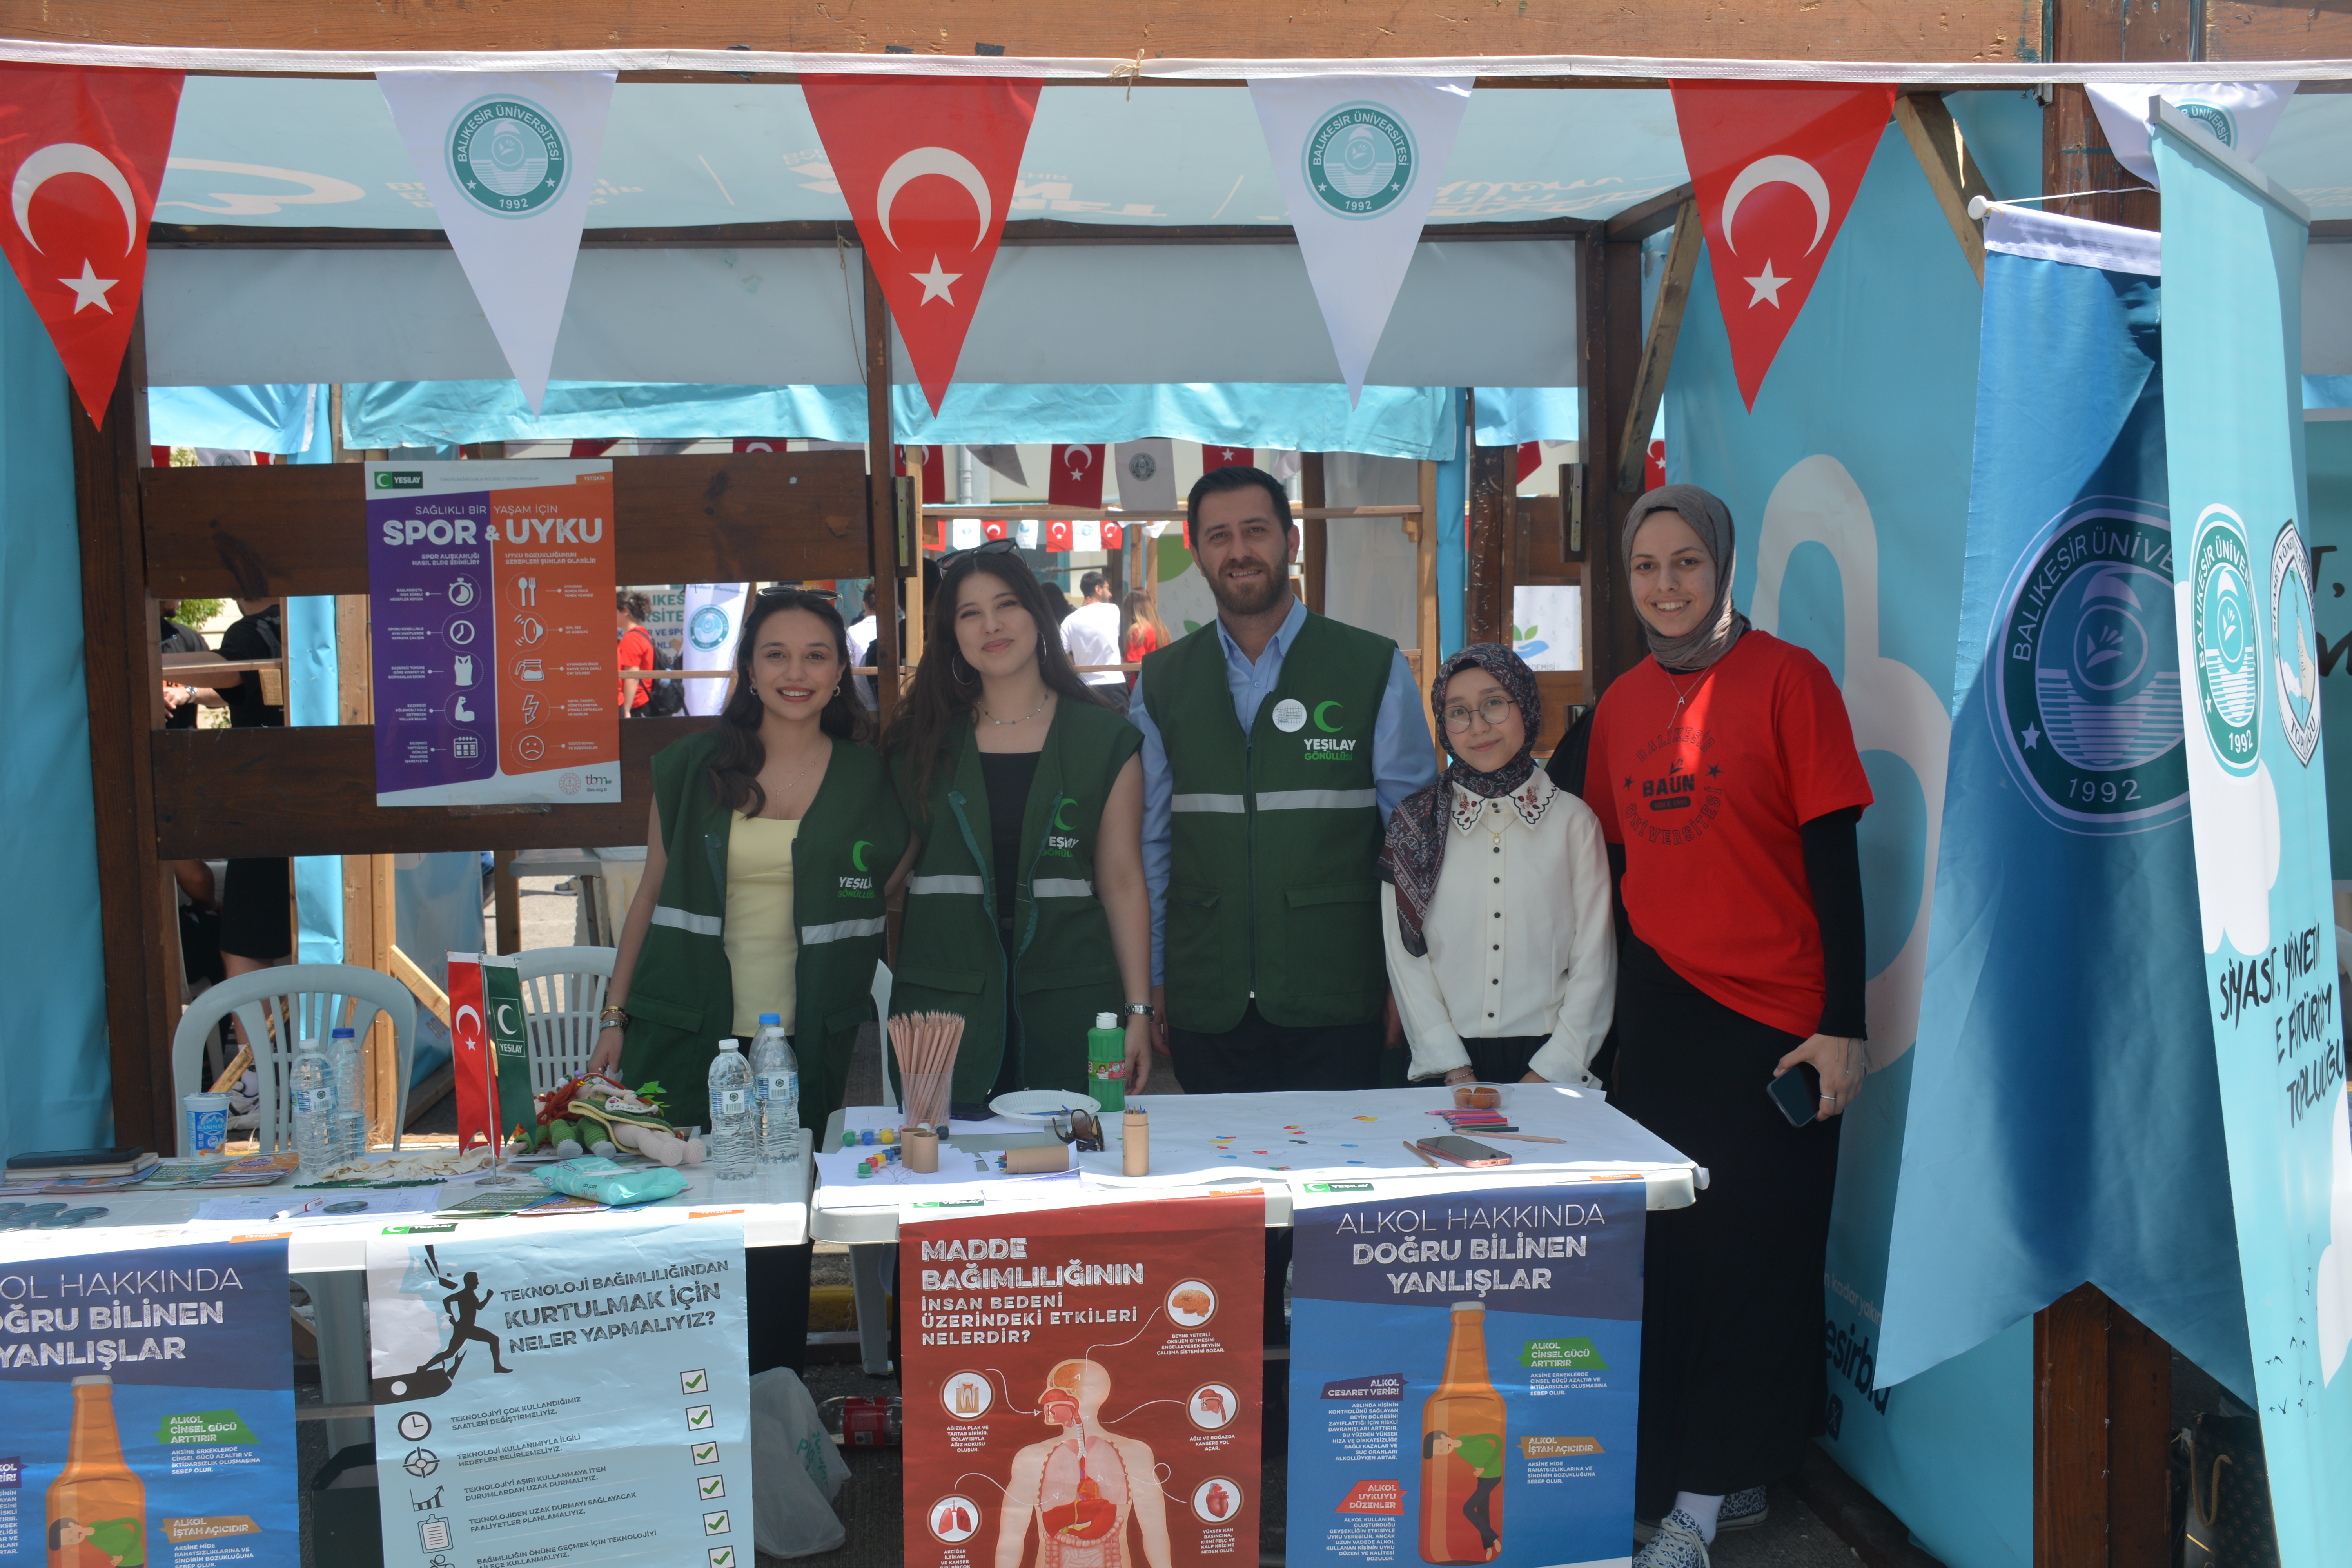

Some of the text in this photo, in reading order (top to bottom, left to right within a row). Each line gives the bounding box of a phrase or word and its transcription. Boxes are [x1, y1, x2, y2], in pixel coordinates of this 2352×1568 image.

[458, 104, 562, 162] BALIKESİR ÜNİVERSİTESİ
[2191, 106, 2229, 142] ÜNİVERSİT
[1313, 111, 1409, 166] BALIKESİR ÜNİVERSİTESİ
[499, 198, 529, 209] 1992
[1345, 200, 1372, 211] 1992
[394, 476, 421, 485] YEŞİLAY
[415, 504, 487, 515] SAĞLIKLI BİR
[493, 503, 558, 516] YAŞAM İÇİN
[383, 518, 602, 546] SPOR & UYKU
[439, 552, 480, 561] ALIŞKANLIĞI
[2013, 534, 2088, 661] BALIKESİR
[2196, 544, 2215, 668] BALIKESİR
[1304, 738, 1356, 751] YEŞİLAY
[1636, 727, 1715, 762] BALIKESİR
[2229, 730, 2253, 753] 1992
[1304, 750, 1353, 761] GÖNÜLLÜSÜ
[1642, 773, 1695, 798] BAUN
[2069, 778, 2142, 803] 1992
[1654, 799, 1688, 809] SINCE 1992
[1625, 786, 1722, 846] ÜNİVERSİTESİ
[838, 888, 875, 899] GÖNÜLLÜS
[839, 877, 873, 890] YEŞİLA
[499, 1043, 523, 1053] YEŞİLAY
[1336, 1203, 1606, 1235] ALKOL HAKKINDA
[921, 1237, 1028, 1263] MADDE
[1352, 1231, 1587, 1265] DOĞRU BİLİNEN
[61, 1267, 243, 1298] HAKKINDA
[500, 1259, 729, 1302] TEKNOLOJİ BAĞIMLILIĞINDAN
[922, 1258, 1144, 1292] BAĞIMLILIĞININ
[1386, 1267, 1552, 1298] YANLIŞLAR
[1832, 1273, 1858, 1308] kadar
[504, 1278, 721, 1330] KURTULMAK İÇİN
[921, 1291, 1063, 1312] İNSAN BEDENİ
[921, 1305, 1137, 1328] ÜZERİNDEKİ ETKİLERİ
[508, 1310, 716, 1354] NELER YAPMALIYIZ?
[922, 1328, 1031, 1346] NELERDİR?
[0, 1336, 187, 1370] YANLIŞLAR
[1531, 1342, 1561, 1350] ALKOL
[1531, 1348, 1590, 1359] CİNSEL GÜCÜ
[1530, 1359, 1572, 1367] ARTTIRIR
[1328, 1387, 1399, 1397] CESARET VERİR!
[1370, 1378, 1400, 1387] ALKOL
[450, 1396, 582, 1423] TEKNOLOJİYİ ÇOK KULLANDIĞIMIZ
[452, 1408, 558, 1431] SAATLERİ DEĞİŞTİRMELİYİZ.
[169, 1416, 204, 1425] ALKOL
[170, 1421, 238, 1434] CİNSEL GÜCÜ
[170, 1434, 217, 1444] ARTTIRIR
[456, 1432, 581, 1460] TEKNOLOJİ KULLANIMIYLA İLGİLİ
[1528, 1437, 1558, 1445] ALKOL
[1528, 1444, 1593, 1455] İŞTAH AÇICIDIR
[196, 1446, 238, 1454] ERKEKLERDE
[458, 1445, 563, 1467] HEDEFLER BELİRLEMELİYİZ.
[1349, 1500, 1396, 1509] DÜZENLER
[173, 1517, 207, 1527] ALKOL
[173, 1524, 249, 1538] İŞTAH AÇICIDIR
